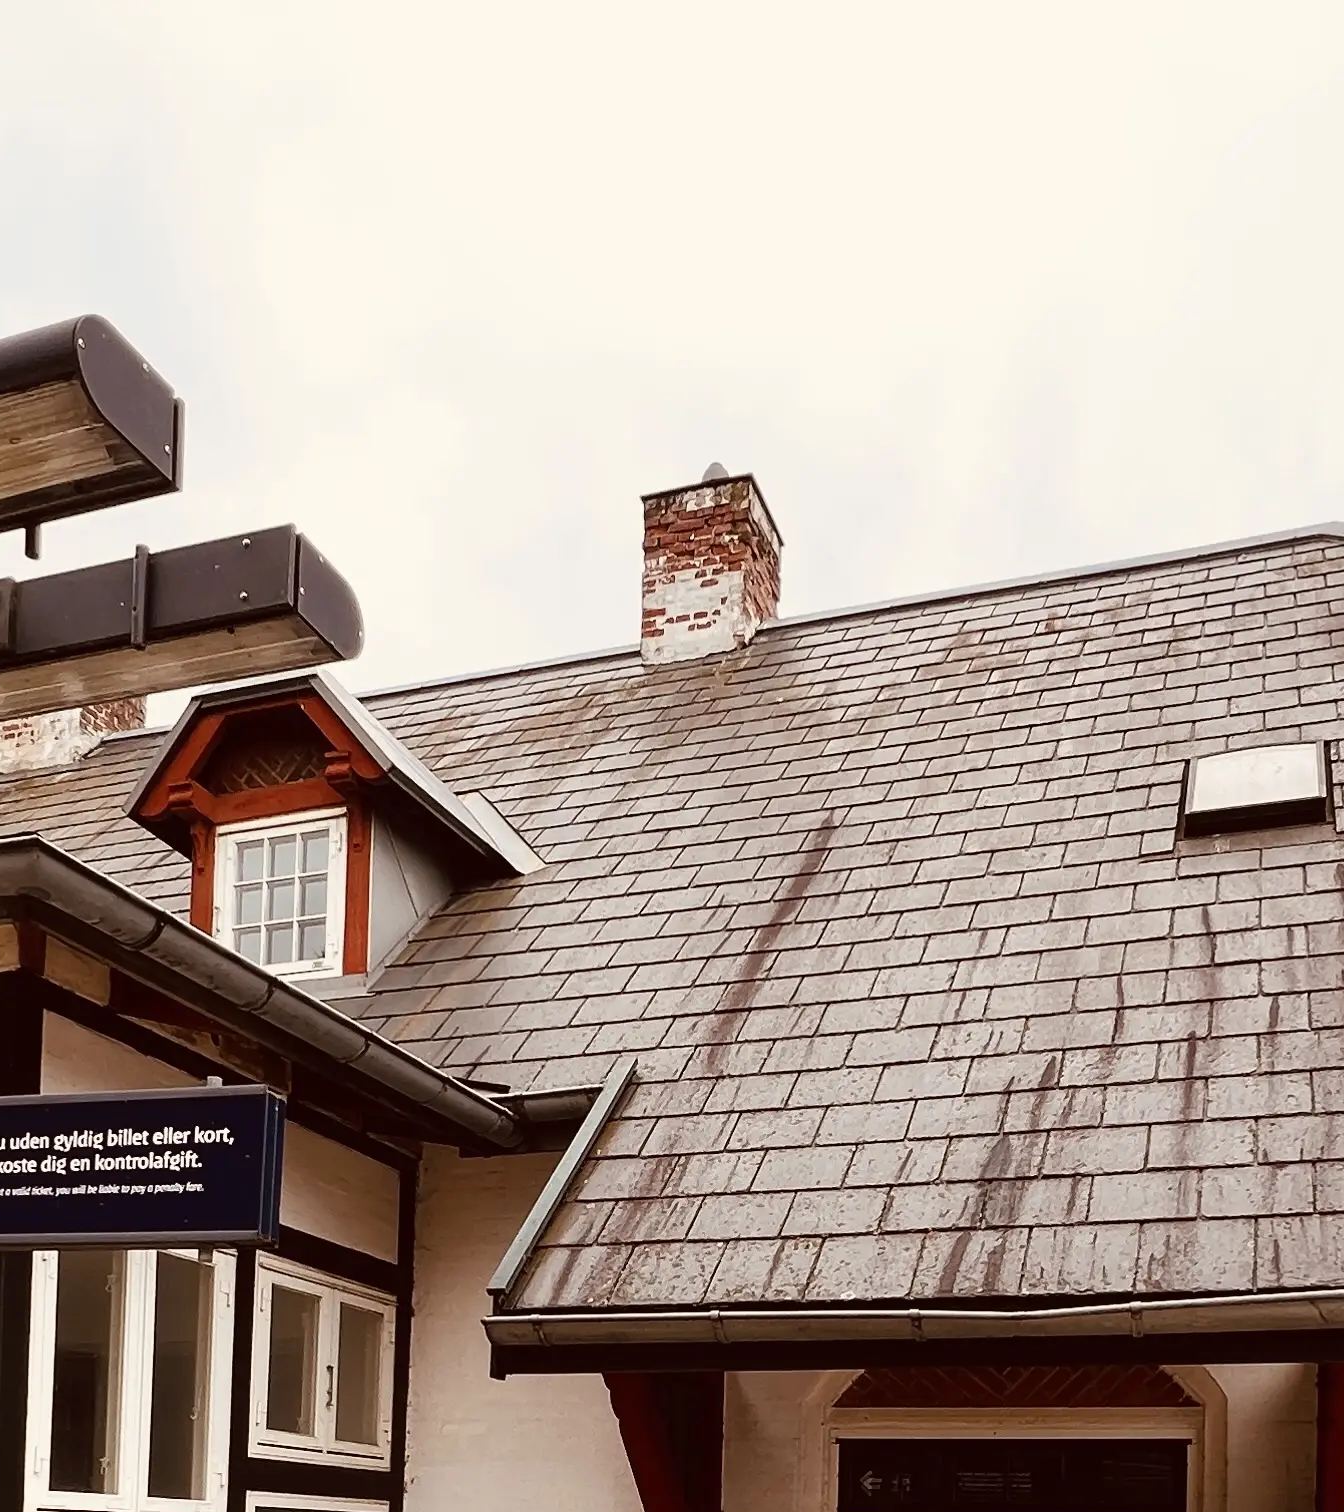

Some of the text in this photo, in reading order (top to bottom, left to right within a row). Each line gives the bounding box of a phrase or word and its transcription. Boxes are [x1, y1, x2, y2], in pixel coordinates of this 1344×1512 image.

[9, 1132, 50, 1150] uden
[53, 1129, 104, 1152] gyldig
[106, 1128, 150, 1147] billet
[152, 1126, 192, 1145] eller
[194, 1125, 235, 1145] kort,
[40, 1154, 68, 1175] dig
[69, 1157, 91, 1172] en
[94, 1150, 203, 1172] kontrolafgift.
[87, 1183, 98, 1194] be
[130, 1184, 146, 1195] pay
